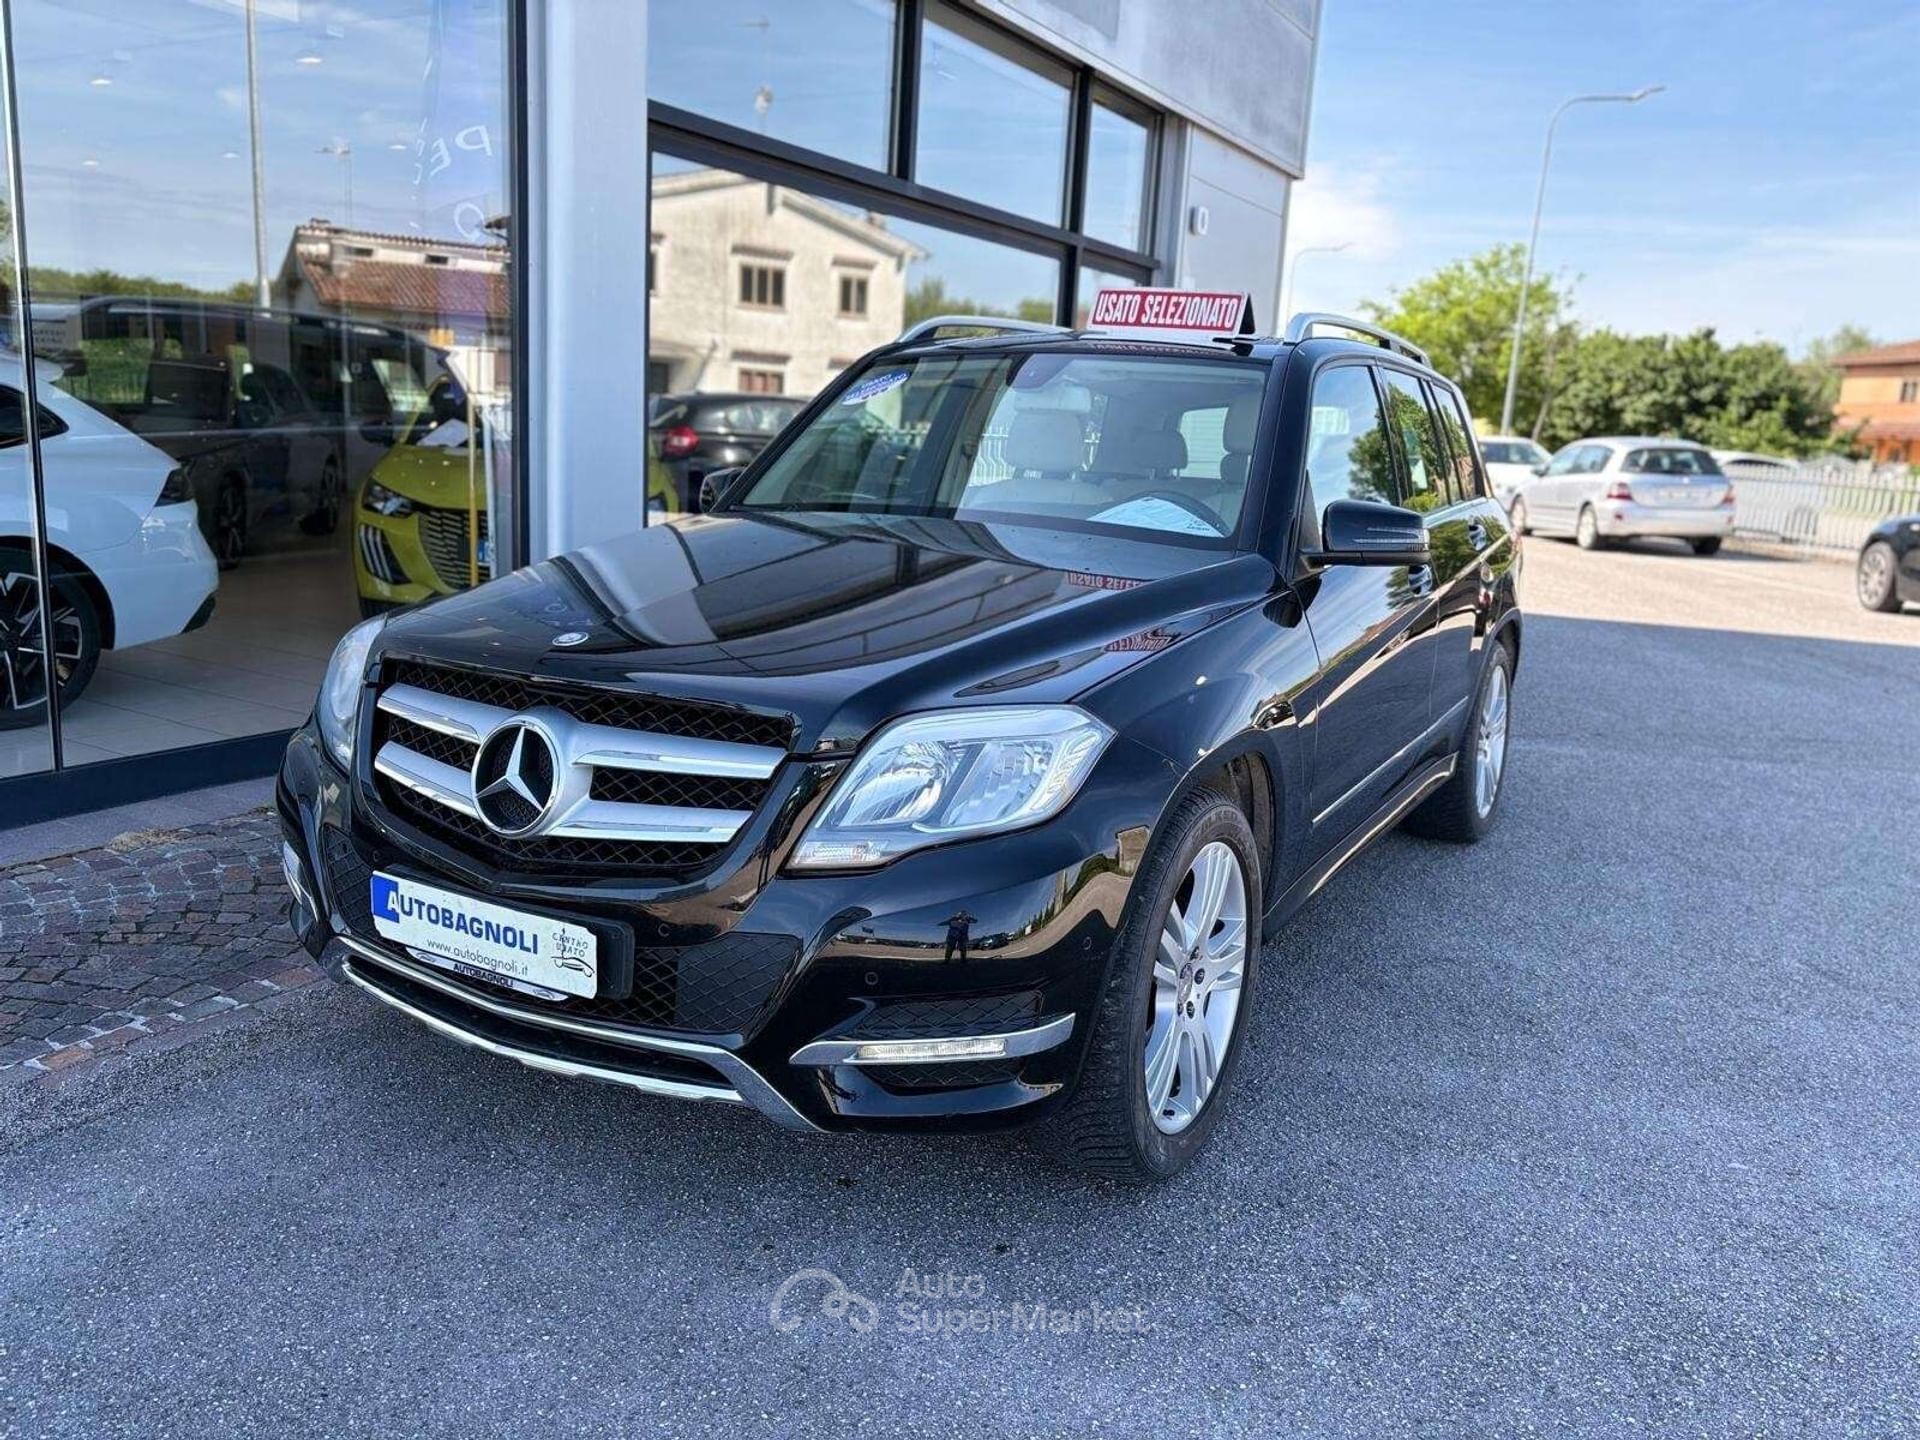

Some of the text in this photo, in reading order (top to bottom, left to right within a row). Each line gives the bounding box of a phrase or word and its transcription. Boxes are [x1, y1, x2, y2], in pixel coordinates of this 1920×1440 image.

[1095, 293, 1238, 329] USATO SELEZIONATO
[387, 890, 539, 955] AUTOBAGNOLI
[427, 937, 529, 976] www.autobagnoli.it
[453, 963, 514, 988] AUTOBAGNOLI
